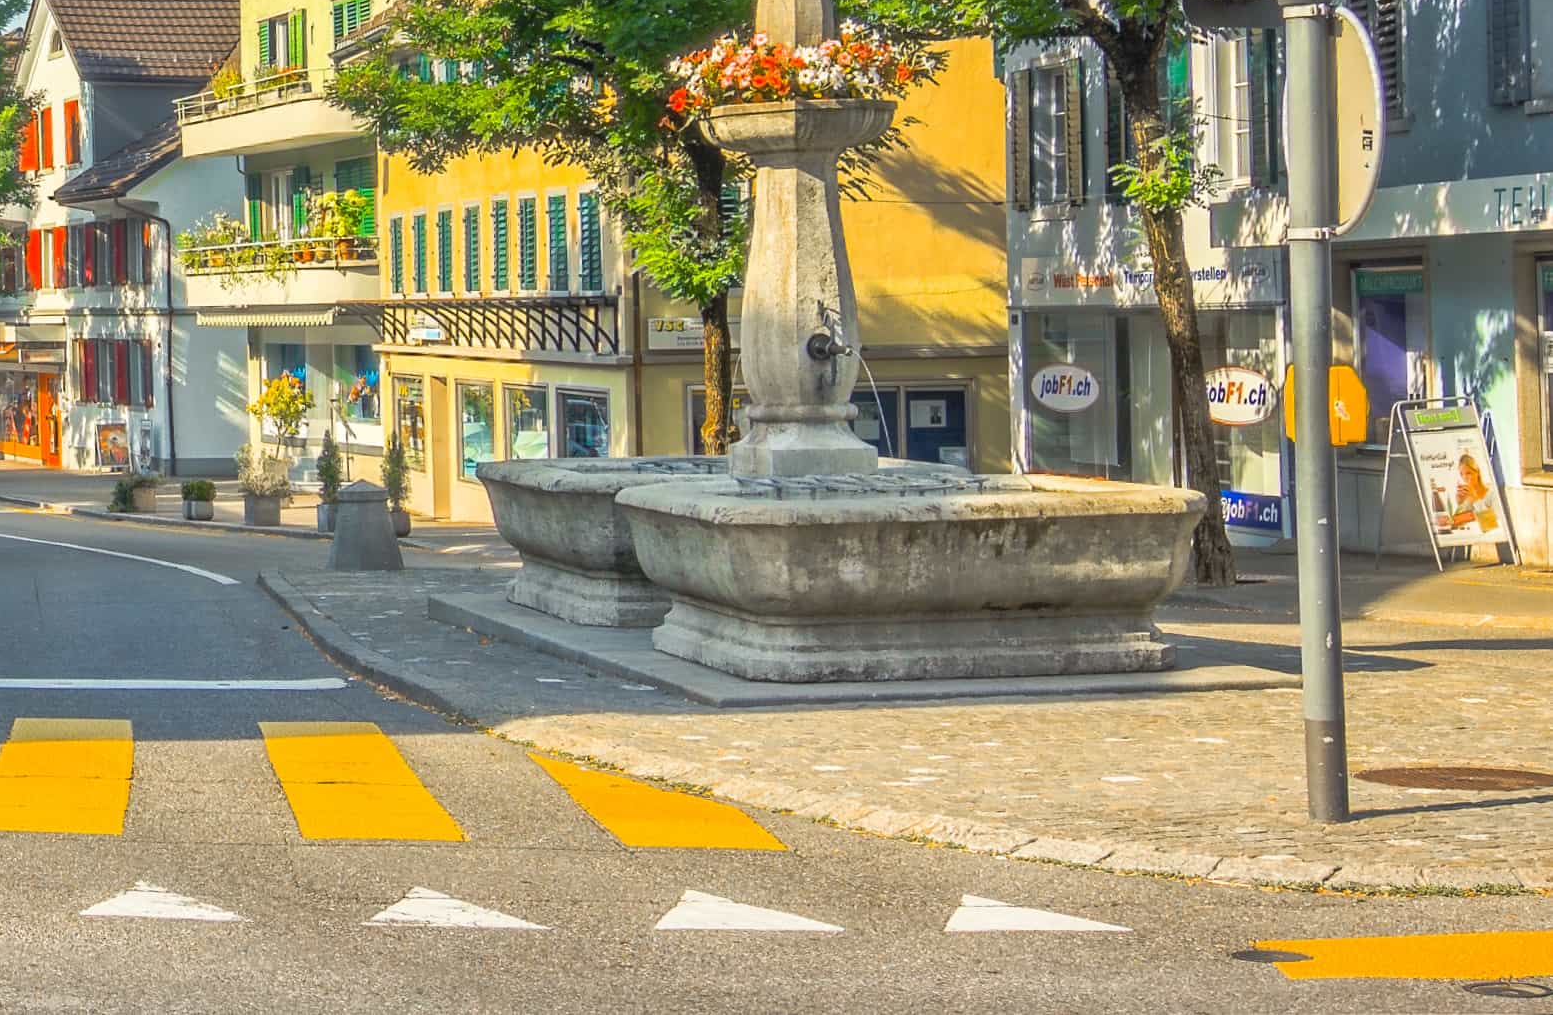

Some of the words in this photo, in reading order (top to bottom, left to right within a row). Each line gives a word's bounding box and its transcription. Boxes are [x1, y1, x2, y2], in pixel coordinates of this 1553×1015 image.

[1124, 270, 1154, 285] Tempor
[1040, 373, 1091, 399] jobF1.ch
[1206, 381, 1266, 405] obF1.ch
